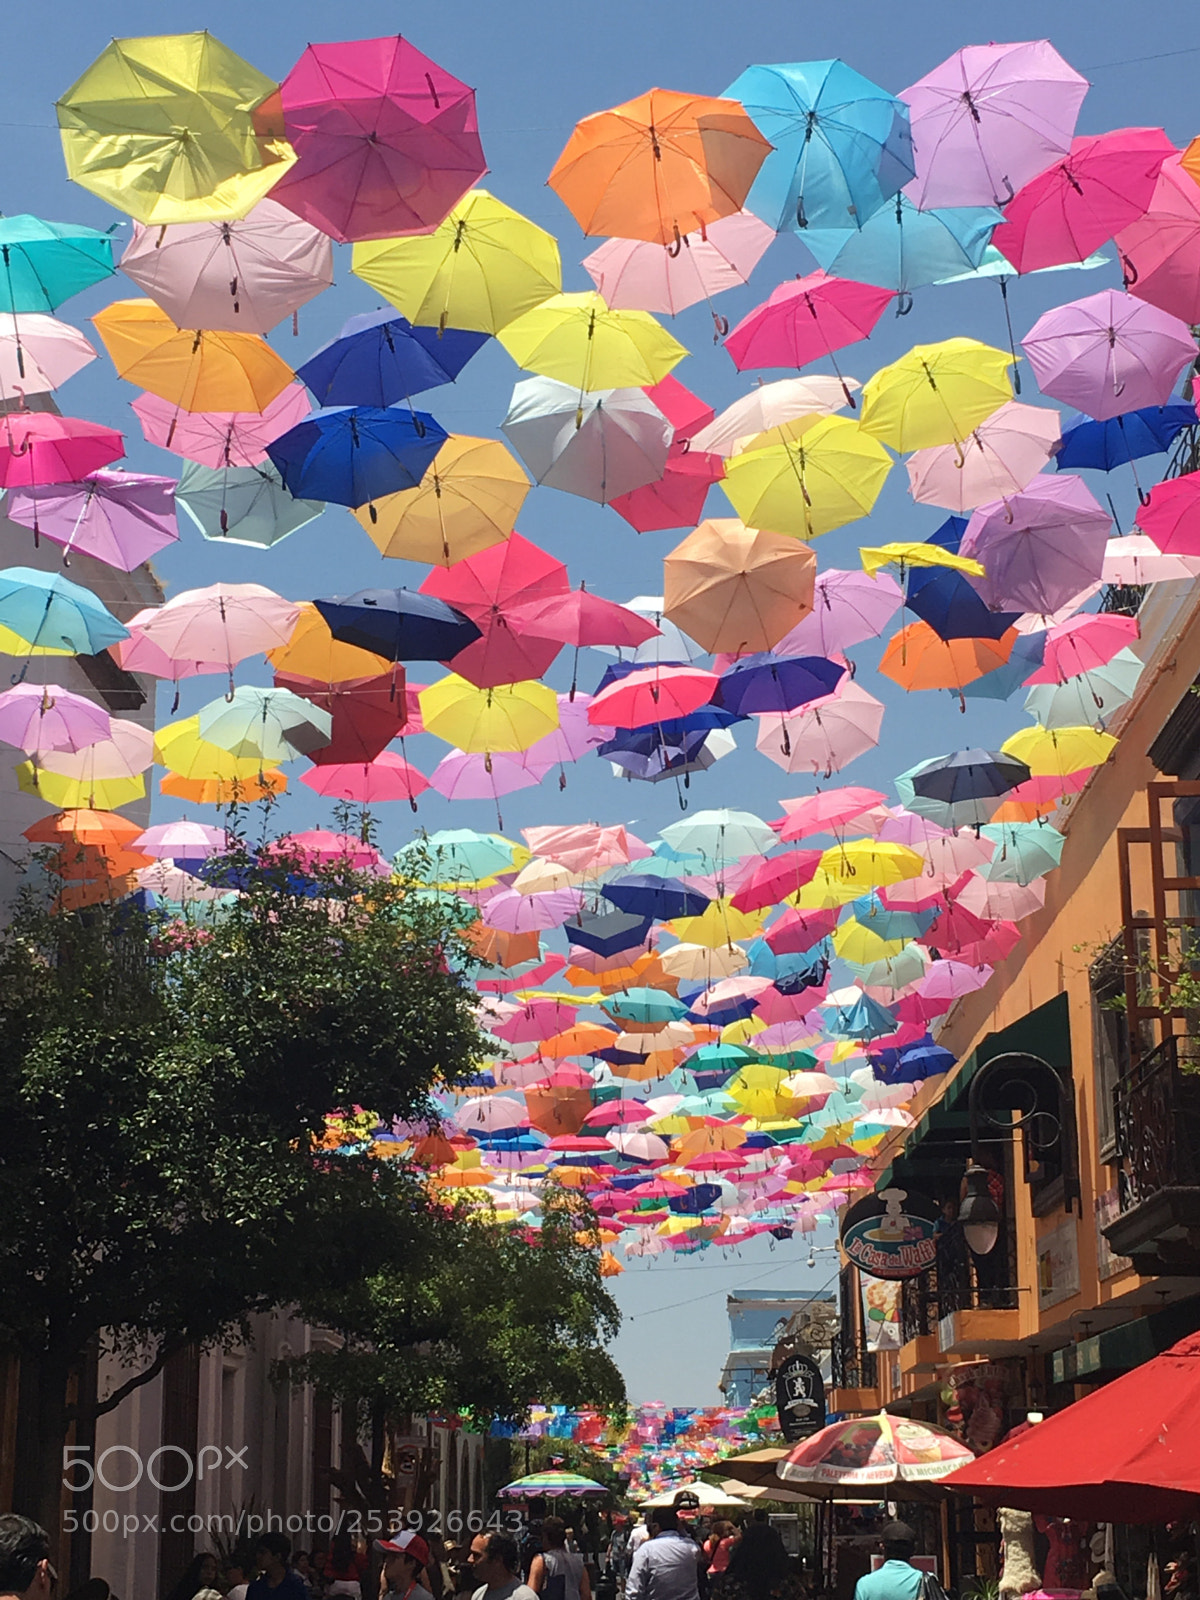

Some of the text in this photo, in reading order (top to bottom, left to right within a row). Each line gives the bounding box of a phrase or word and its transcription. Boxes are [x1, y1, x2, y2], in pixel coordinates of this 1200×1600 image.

[848, 1238, 864, 1255] La
[860, 1243, 889, 1266] Casa
[889, 1255, 901, 1266] del
[903, 1467, 915, 1477] LA
